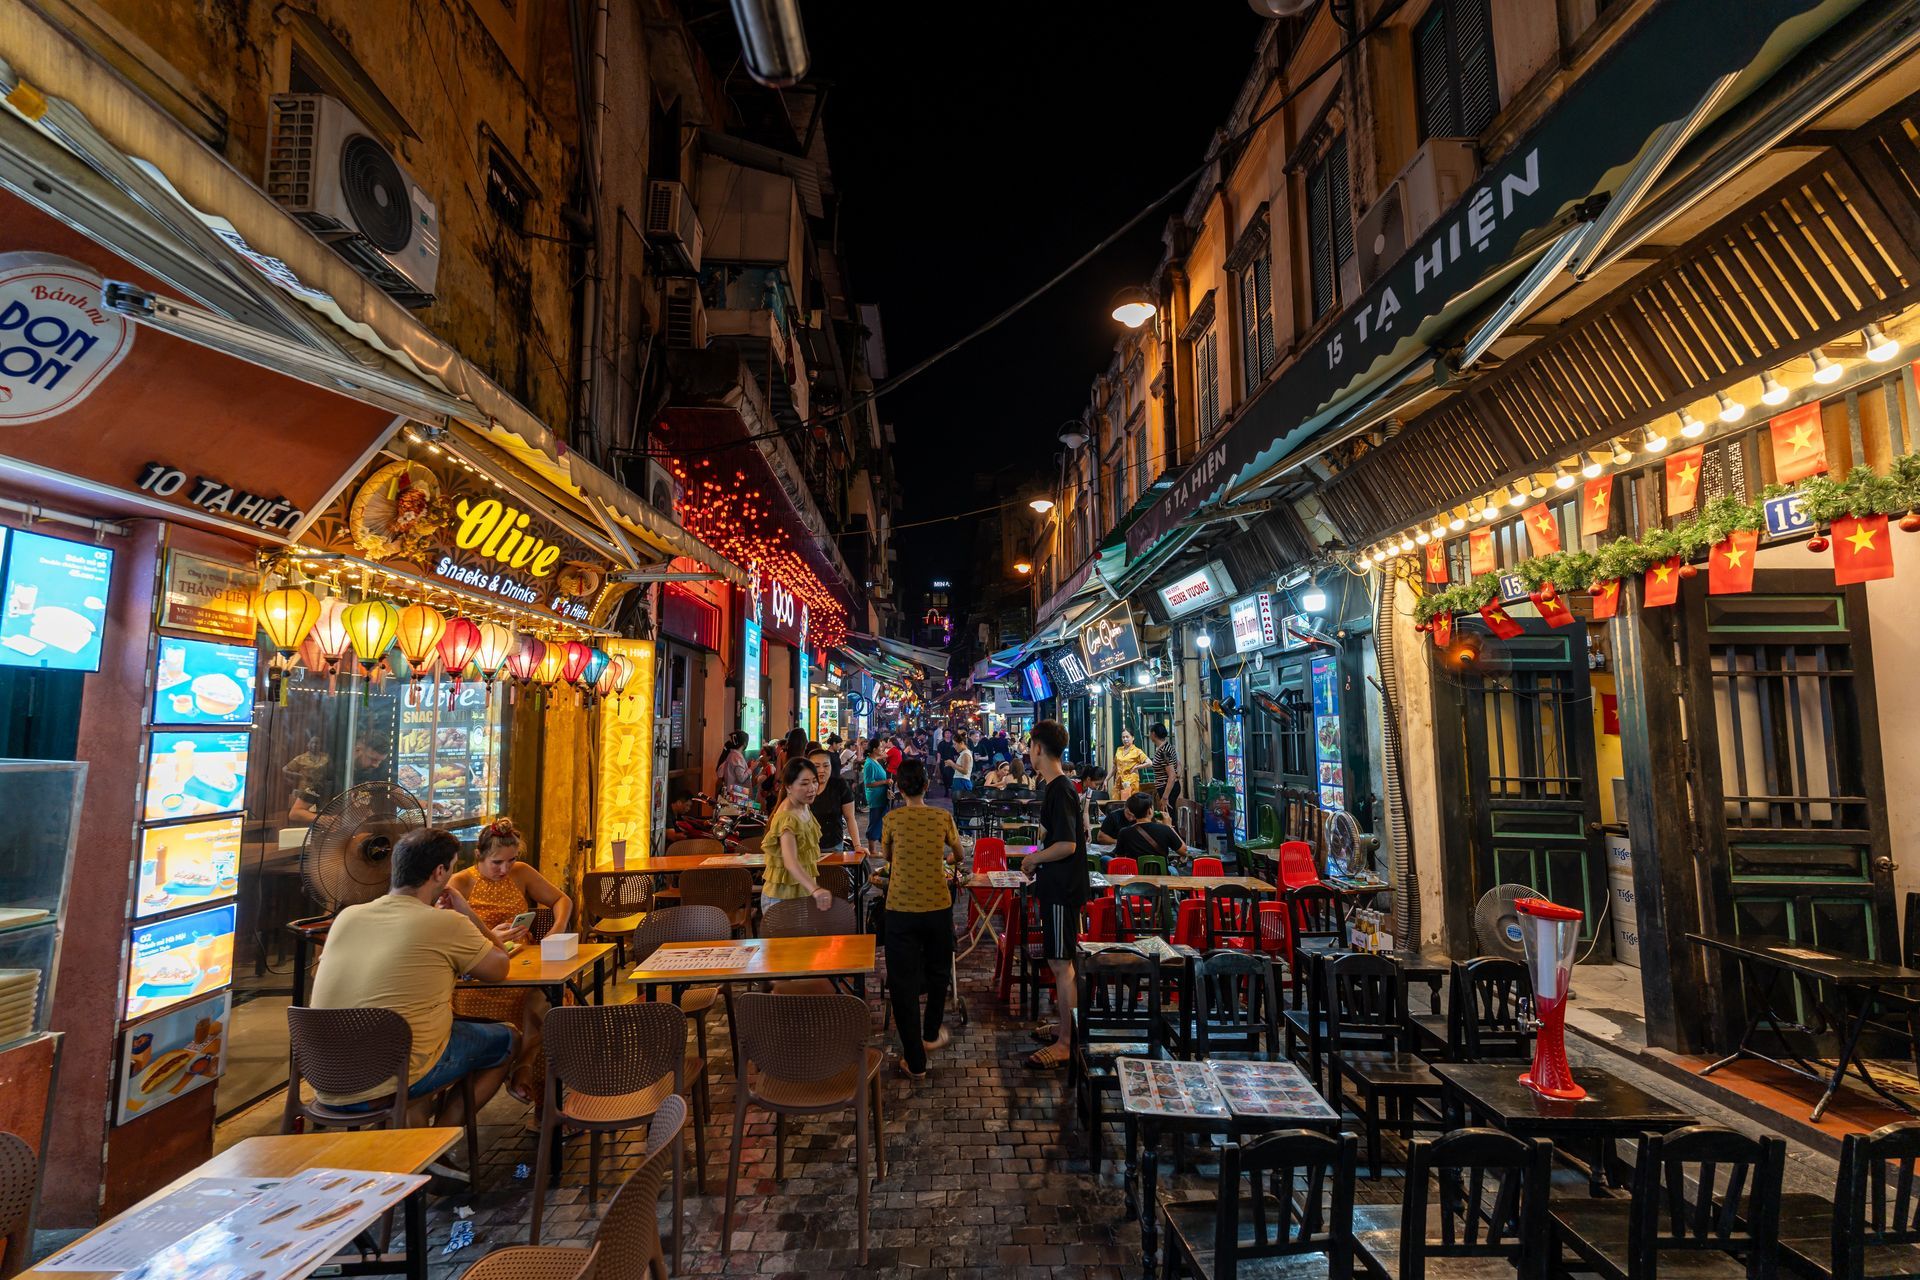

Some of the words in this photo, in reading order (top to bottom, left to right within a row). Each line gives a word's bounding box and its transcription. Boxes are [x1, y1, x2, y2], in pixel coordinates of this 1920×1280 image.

[1327, 333, 1343, 370] 15
[1354, 286, 1401, 343] TẠ
[1414, 148, 1540, 295] HIỆN
[31, 285, 89, 310] Bánh
[141, 466, 187, 496] 10
[193, 480, 234, 513] TẠ
[1174, 482, 1188, 508] TẠ
[1191, 443, 1226, 493] HIỆN
[1774, 501, 1808, 531] 15
[455, 498, 560, 577] Olive
[436, 556, 489, 589] Snacks
[488, 575, 499, 592] &
[500, 579, 537, 604] Drinks
[1505, 577, 1521, 596] 15
[551, 597, 560, 610] 8
[569, 603, 588, 621] Hiện
[1059, 653, 1085, 684] THE
[1613, 847, 1631, 860] Tige
